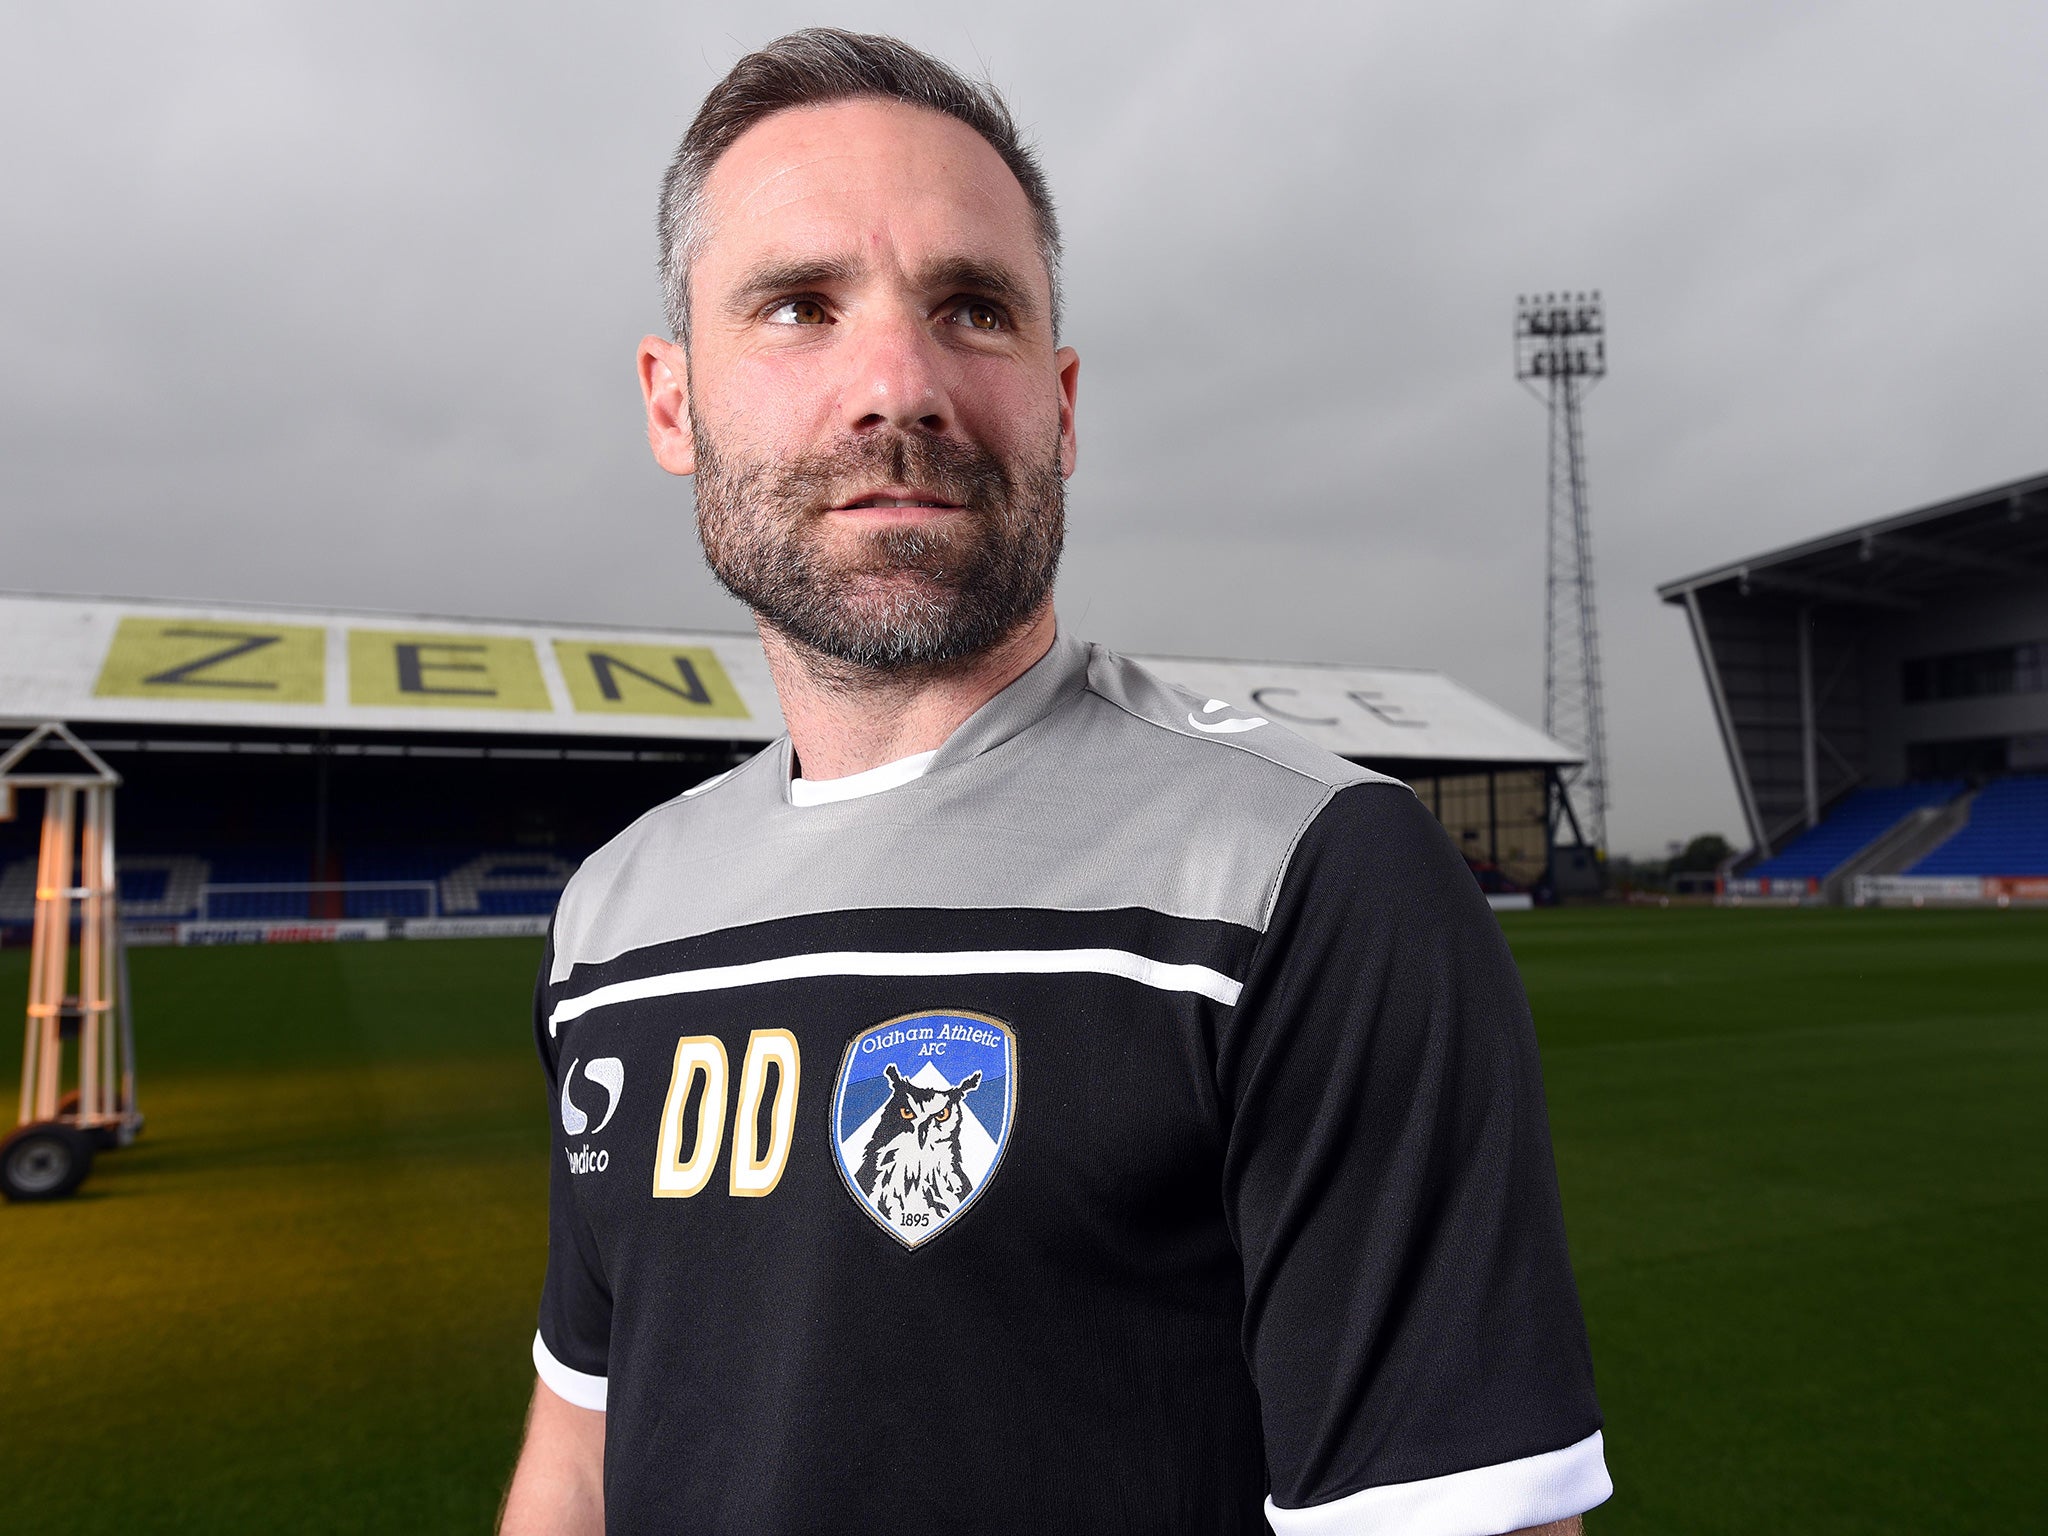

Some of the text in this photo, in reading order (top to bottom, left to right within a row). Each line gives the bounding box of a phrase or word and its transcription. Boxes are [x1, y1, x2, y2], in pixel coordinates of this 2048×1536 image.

[142, 626, 713, 706] ZEN
[862, 1023, 1001, 1054] Oldham Athletic
[917, 1042, 947, 1056] AFC
[652, 1028, 801, 1199] DD
[900, 1212, 930, 1227] 1895
